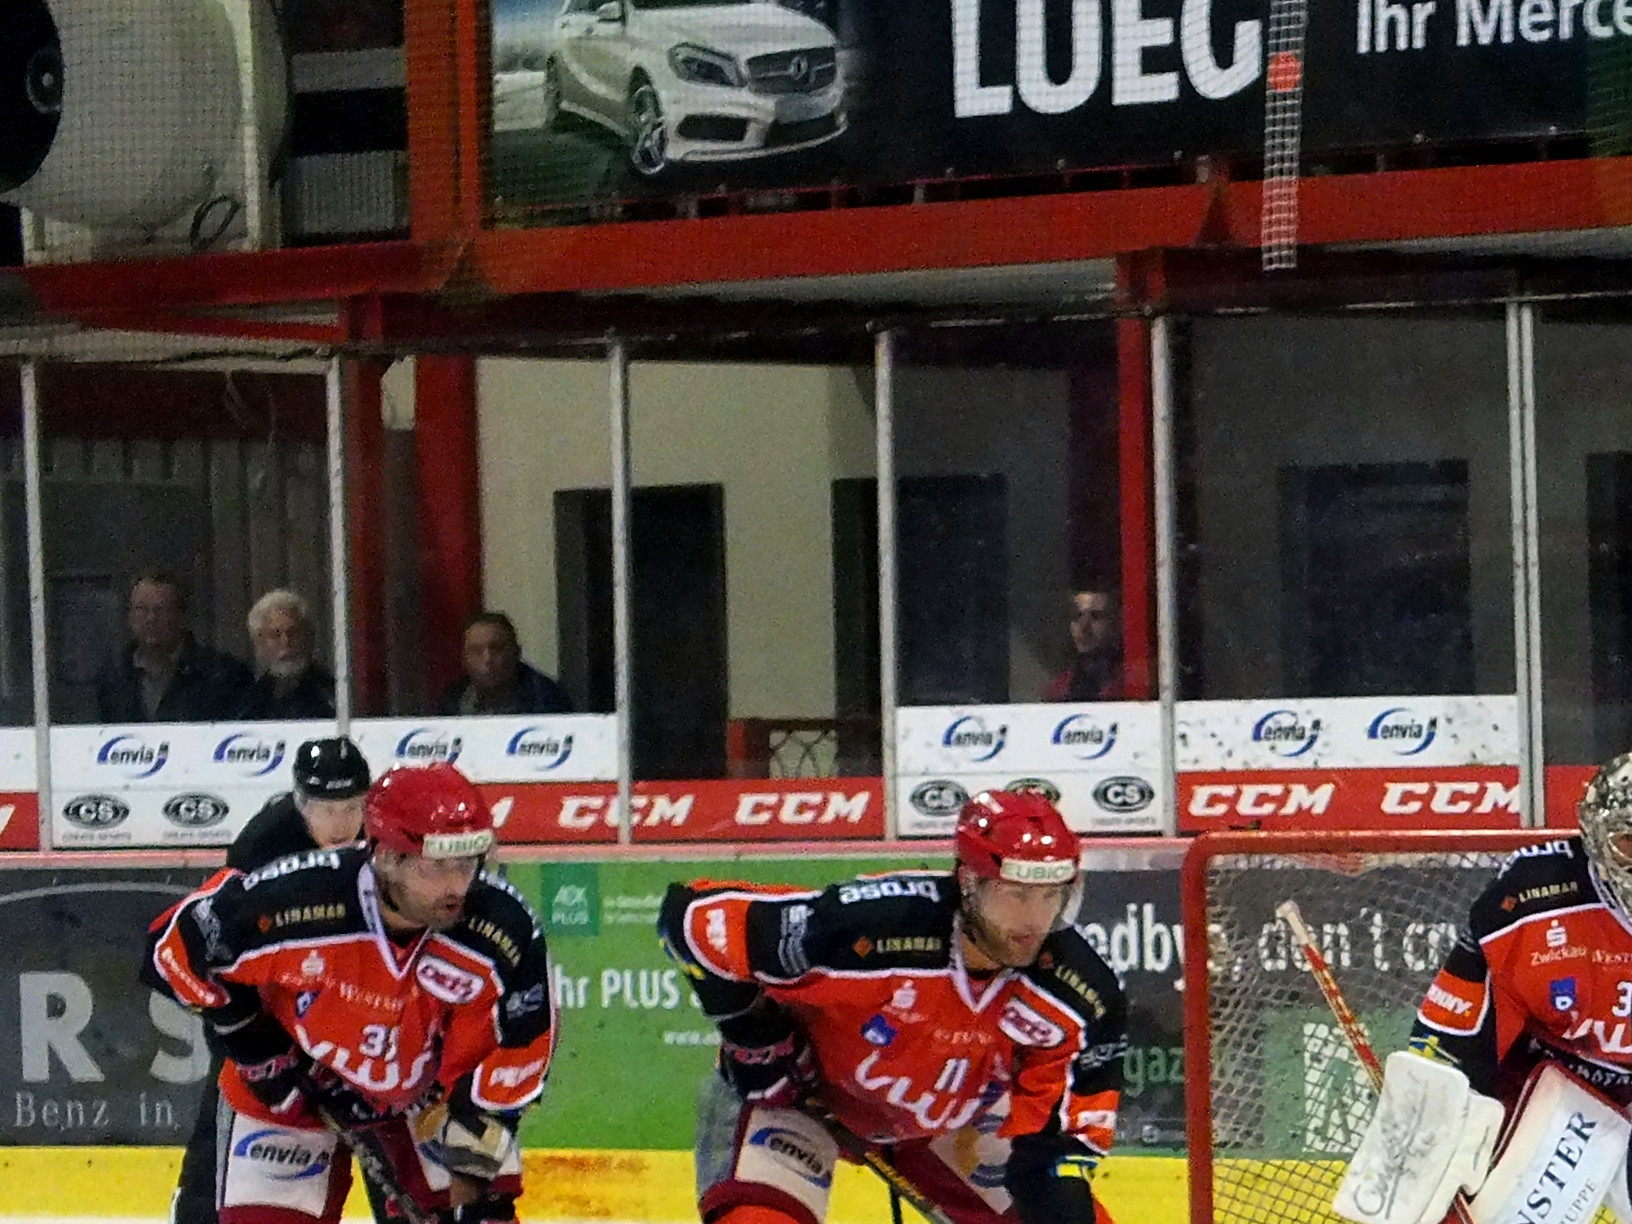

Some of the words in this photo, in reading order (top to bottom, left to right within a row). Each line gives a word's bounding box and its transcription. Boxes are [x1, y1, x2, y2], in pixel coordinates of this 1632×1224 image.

[1356, 0, 1434, 54] Ihr
[557, 793, 694, 828] CCM
[734, 791, 871, 826] CCM
[1187, 782, 1336, 818] CCM
[1380, 780, 1521, 815] CCM
[554, 964, 590, 1010] hr
[601, 968, 681, 1010] PLUS
[14, 1091, 109, 1129] Benz
